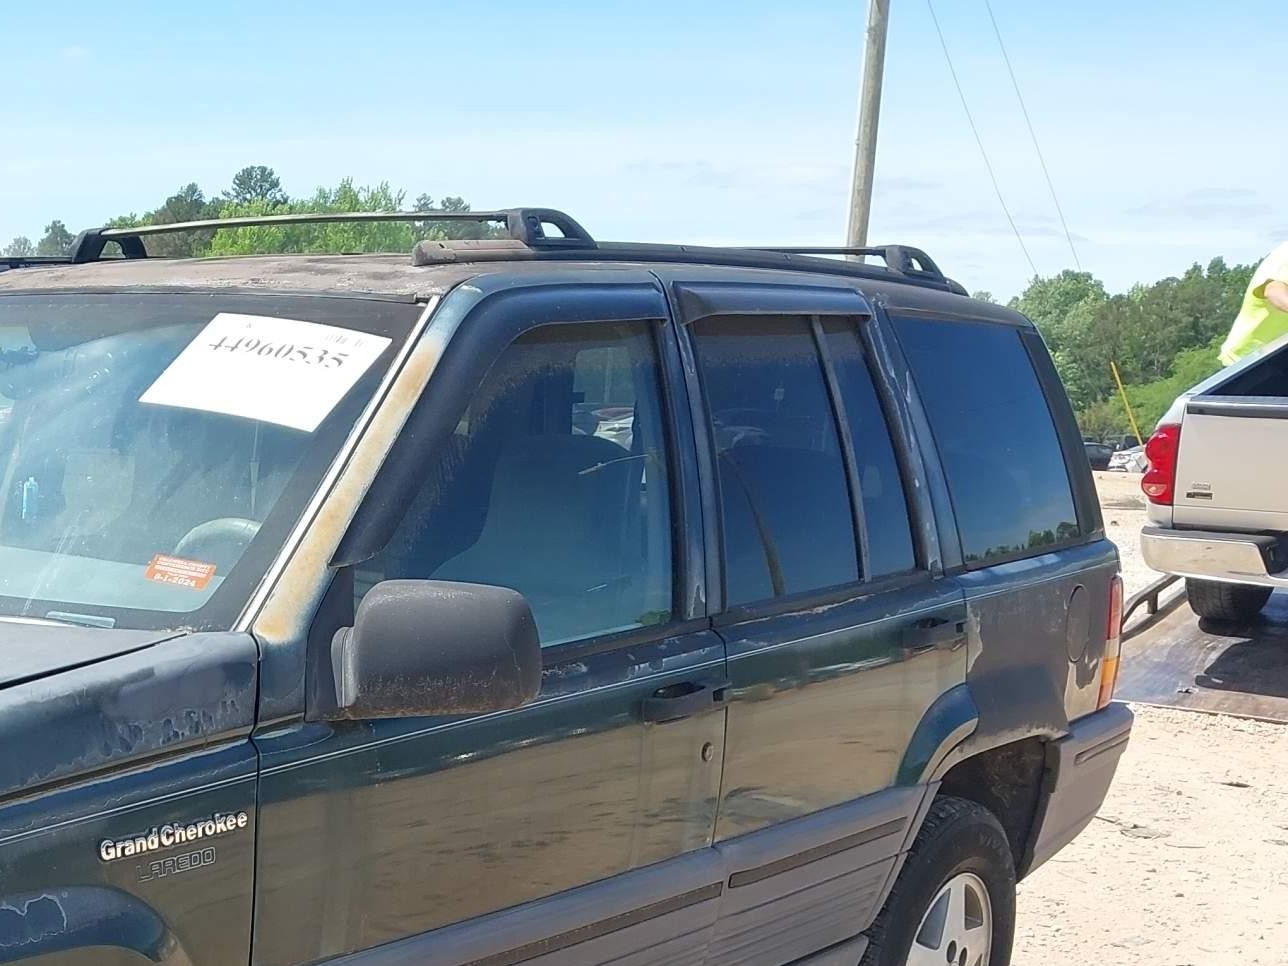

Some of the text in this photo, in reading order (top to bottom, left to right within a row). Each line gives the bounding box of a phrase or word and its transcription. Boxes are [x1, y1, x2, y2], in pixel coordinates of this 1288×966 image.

[209, 336, 350, 368] 44960535
[100, 811, 248, 861] Grand Cherokee
[136, 847, 216, 883] LAREDO
